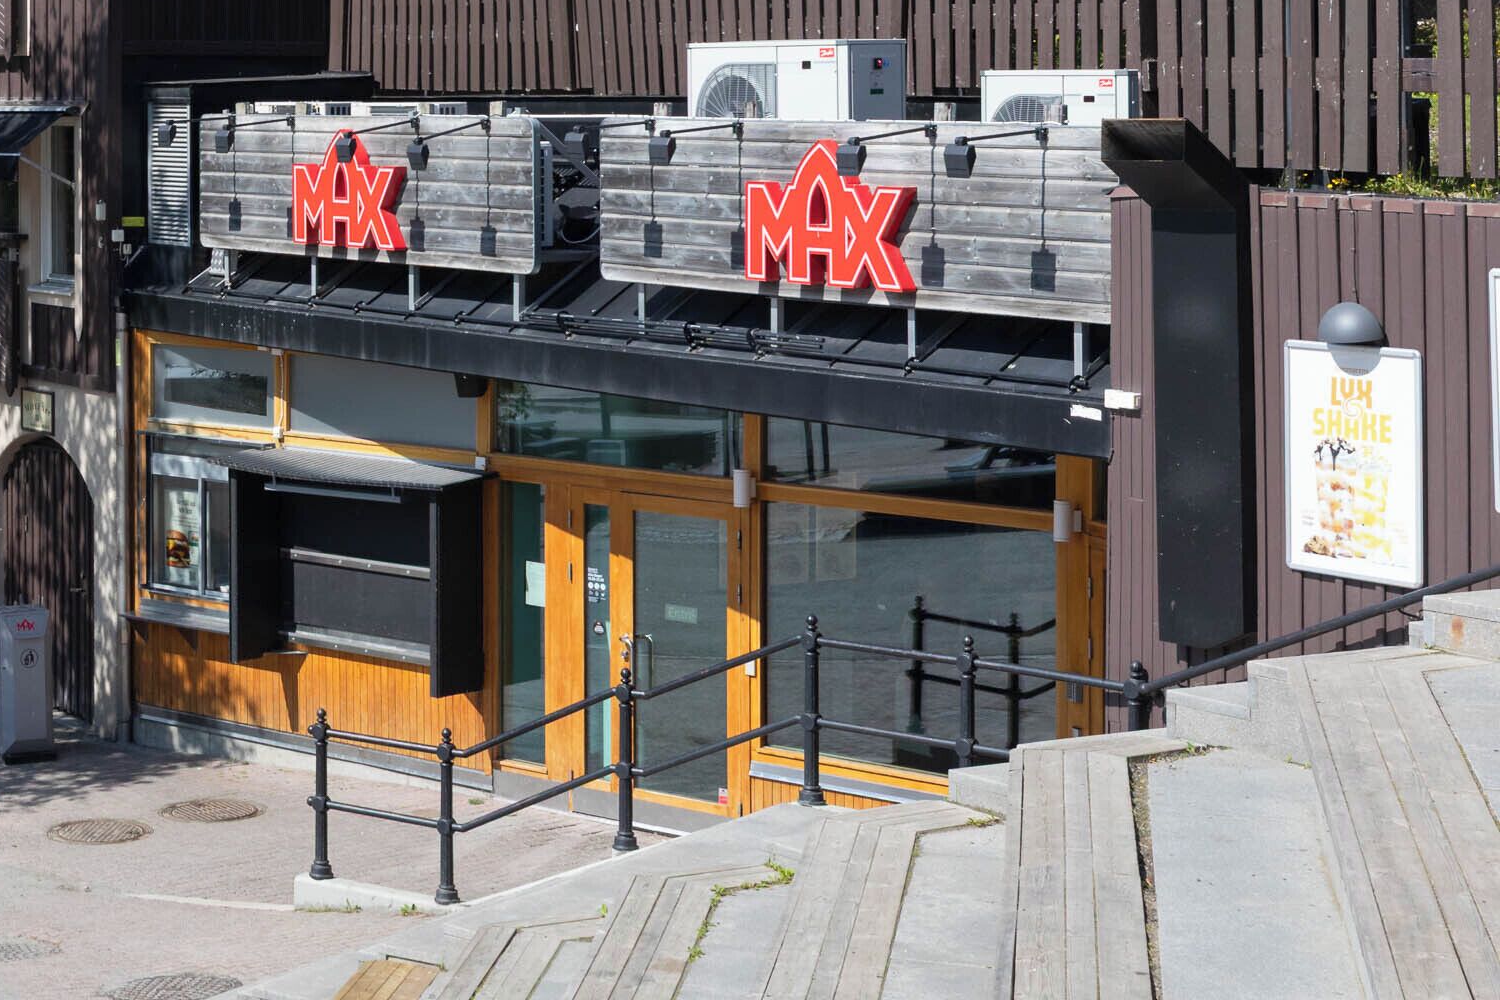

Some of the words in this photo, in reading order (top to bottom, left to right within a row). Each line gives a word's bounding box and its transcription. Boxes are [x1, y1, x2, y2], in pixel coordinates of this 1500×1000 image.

[292, 129, 408, 251] MAX
[745, 139, 918, 292] MAX
[1312, 407, 1393, 443] SHAKE
[16, 618, 35, 631] MAX
